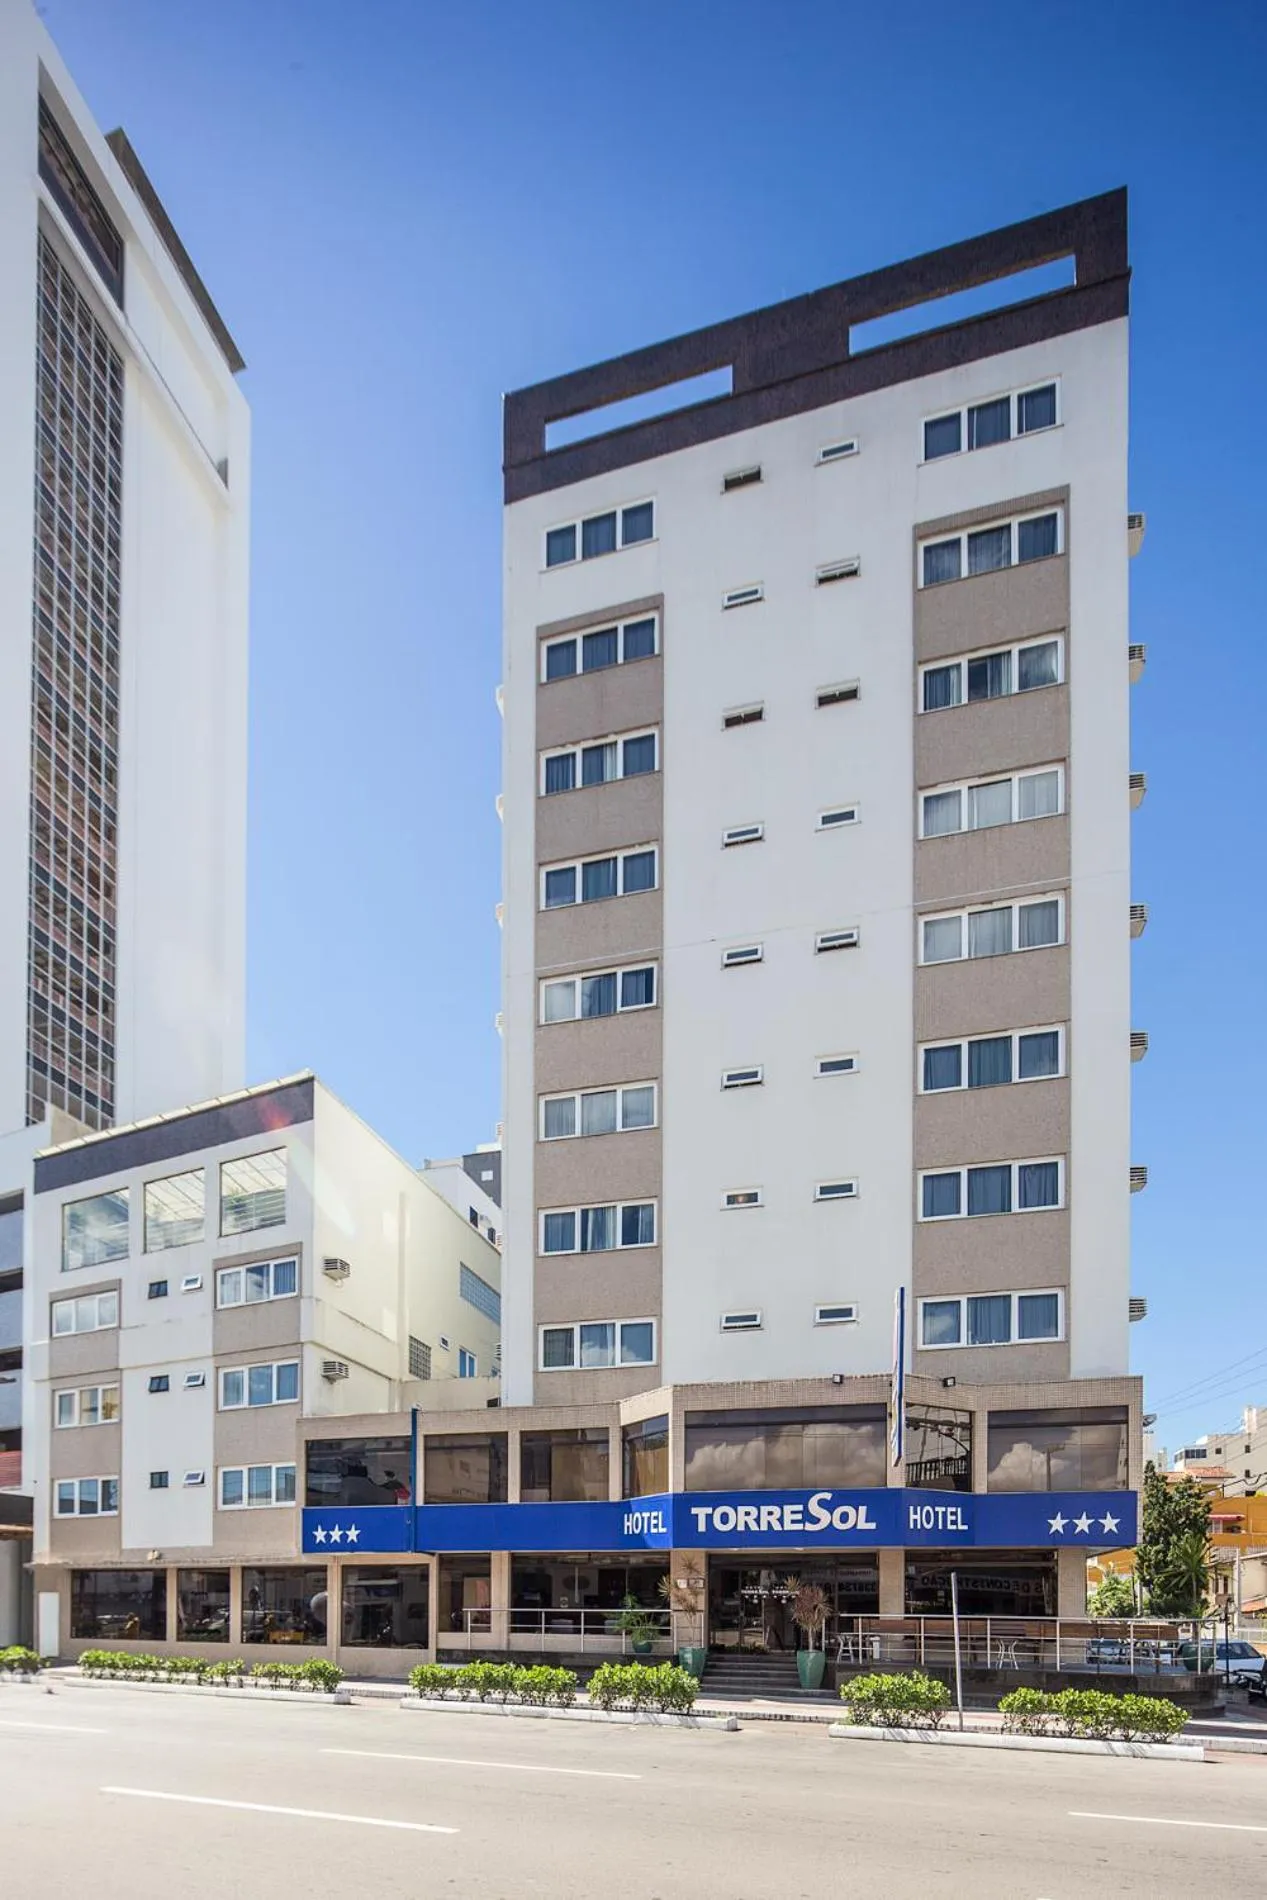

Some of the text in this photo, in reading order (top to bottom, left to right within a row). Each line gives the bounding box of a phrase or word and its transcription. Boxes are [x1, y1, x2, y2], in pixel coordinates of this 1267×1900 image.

[624, 1511, 667, 1534] HOTEL
[691, 1492, 877, 1532] TORRESOL
[909, 1505, 969, 1530] HOTEL
